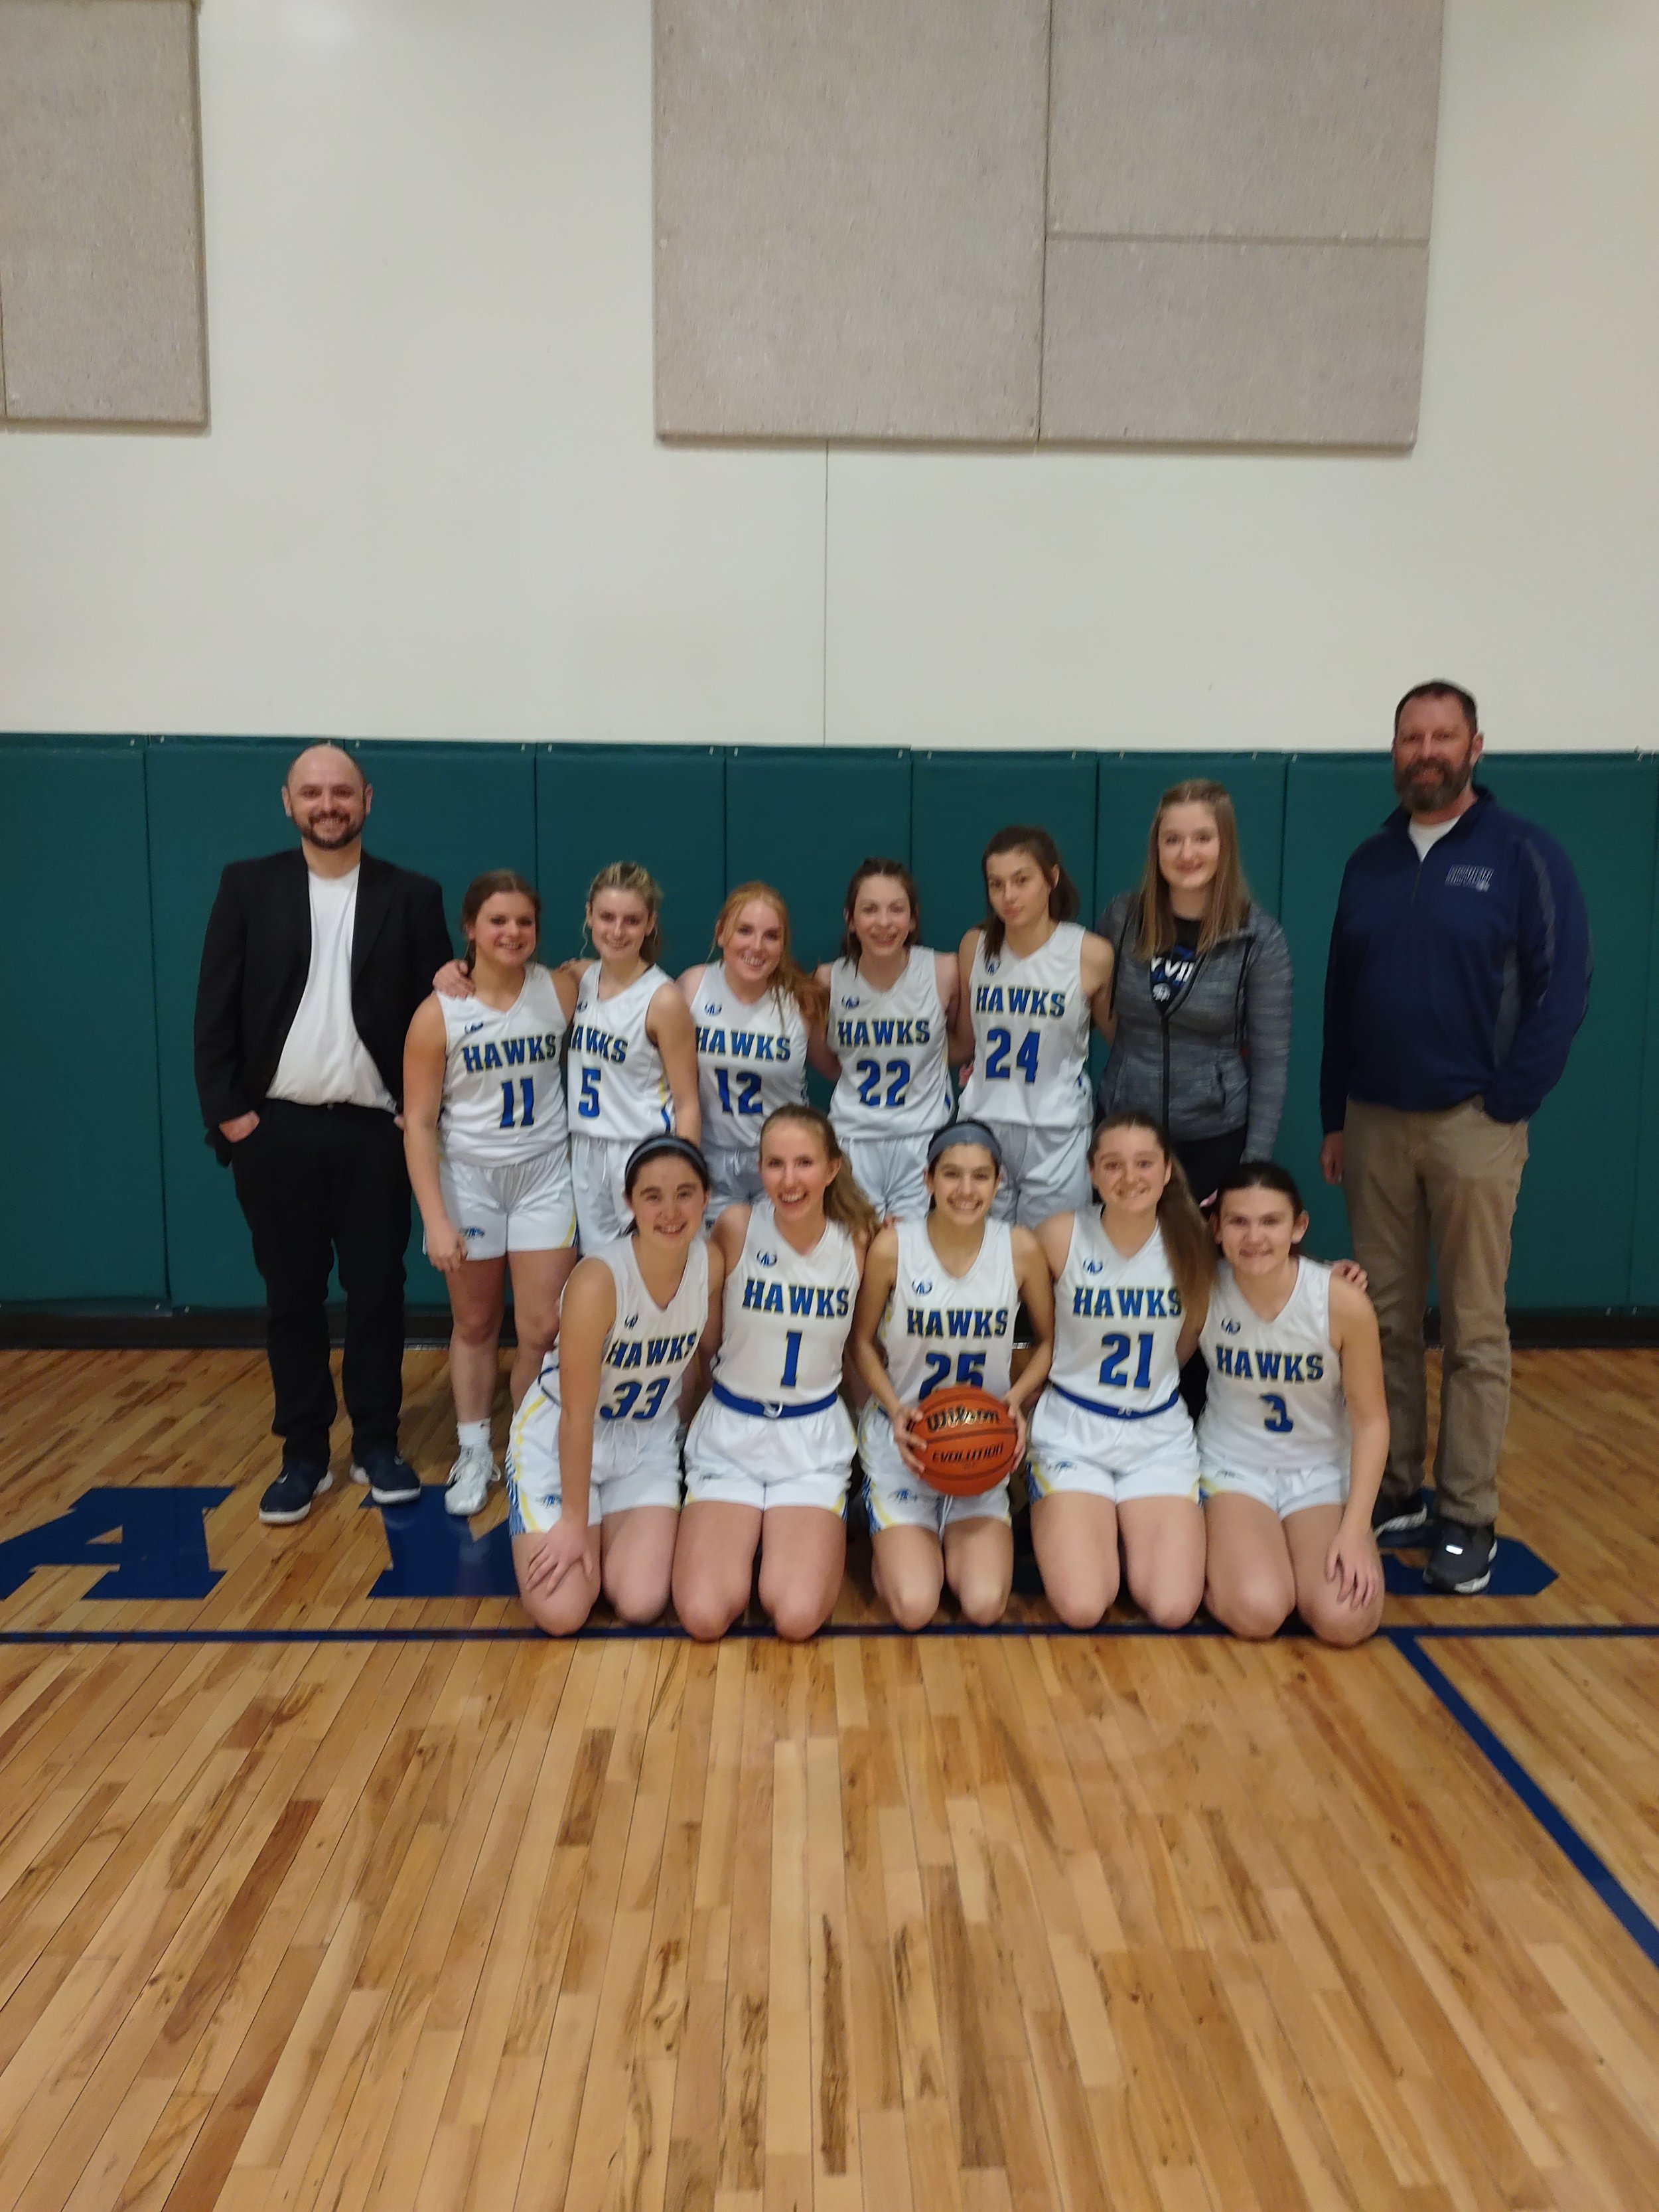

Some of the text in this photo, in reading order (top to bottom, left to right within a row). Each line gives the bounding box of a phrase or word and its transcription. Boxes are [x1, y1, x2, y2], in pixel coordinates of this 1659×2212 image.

[975, 984, 1065, 1018] HAWKS
[463, 1033, 556, 1072] HAWKS
[695, 1026, 791, 1062] HAWKS
[838, 1019, 930, 1047] HAWKS
[985, 1028, 1041, 1083] 24
[499, 1076, 535, 1128] 11
[578, 1068, 601, 1118] 5
[715, 1068, 763, 1114] 12
[857, 1059, 910, 1107] 22
[743, 1277, 849, 1318] HAWKS
[1072, 1286, 1182, 1318] HAWKS
[906, 1308, 1008, 1337] HAWKS
[605, 1331, 697, 1369] HAWKS
[780, 1330, 803, 1388] 1
[1099, 1331, 1153, 1388] 21
[1216, 1345, 1324, 1382] HAWKS
[918, 1352, 987, 1400] 25
[599, 1378, 671, 1421] 33
[1260, 1394, 1293, 1433] 3
